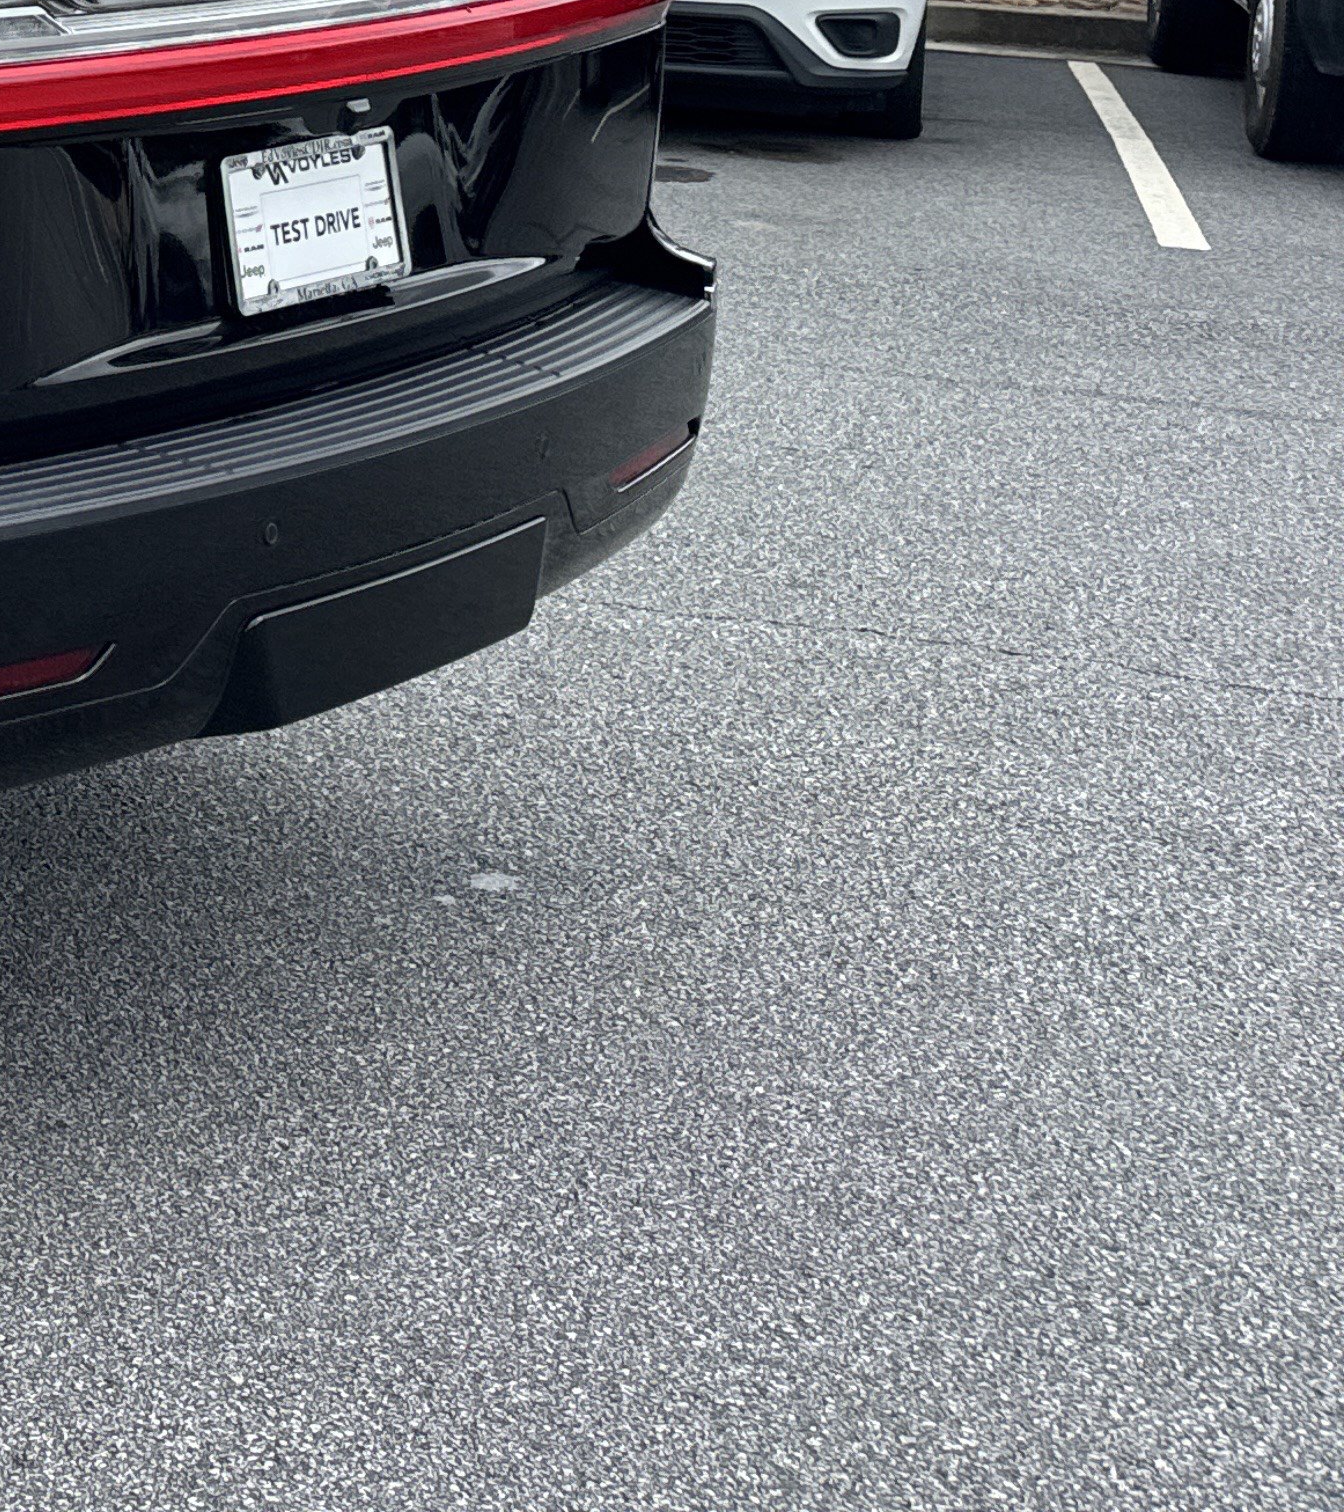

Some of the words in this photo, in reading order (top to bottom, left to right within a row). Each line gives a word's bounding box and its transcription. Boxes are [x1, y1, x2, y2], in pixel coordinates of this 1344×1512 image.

[282, 148, 352, 174] VOYLES
[270, 218, 309, 246] TEST
[314, 207, 361, 237] DRIVE
[373, 236, 393, 249] Jeep
[240, 264, 265, 279] Jeep
